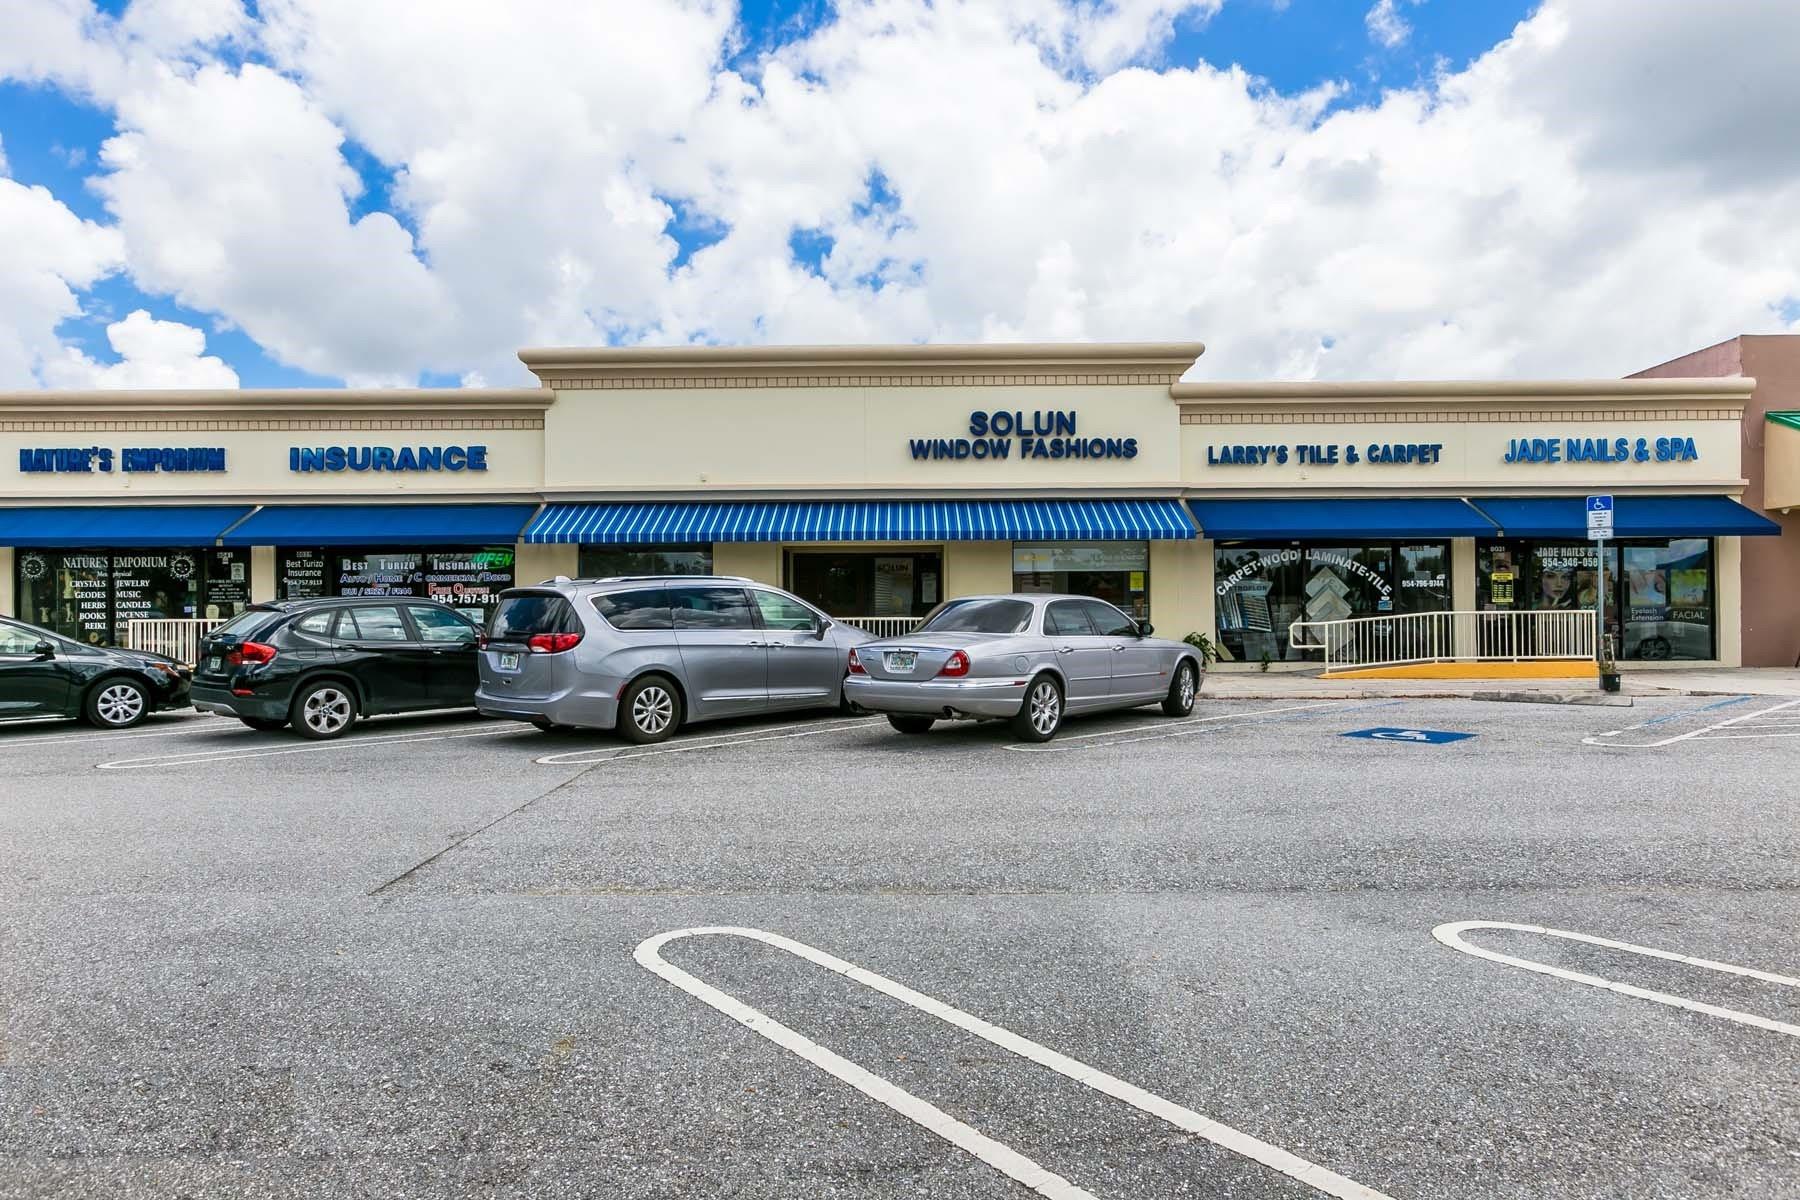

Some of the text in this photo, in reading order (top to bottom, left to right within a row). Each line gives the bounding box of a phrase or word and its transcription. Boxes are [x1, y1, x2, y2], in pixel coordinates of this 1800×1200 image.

[969, 411, 1076, 436] SOLUN
[910, 438, 1138, 459] WINDOW FASHIONS
[1505, 437, 1698, 463] JADE NAILS & SPA
[1207, 443, 1442, 465] LARRY'S TILE & CARPET
[20, 446, 226, 472] NATURE'S EMPORIUM
[289, 446, 488, 472] INSURANCE
[1537, 547, 1559, 557] JADE
[63, 556, 167, 568] NATURE'S EMPORIUM
[286, 559, 324, 568] Best Turizo
[473, 552, 513, 567] OPEN
[287, 568, 322, 577] Insurance
[70, 580, 106, 588] CRYSTALS
[115, 579, 150, 588] JEWELRY
[75, 591, 106, 599] GEODES
[115, 590, 141, 598] MUSIC
[431, 593, 500, 604] 954-757-911
[81, 601, 106, 609] HERBS
[115, 600, 152, 609] CANDLES
[79, 612, 106, 620] BOOKS
[115, 611, 149, 619] INCENSE
[1672, 610, 1705, 619] FACIAL
[84, 622, 106, 630] REIKI
